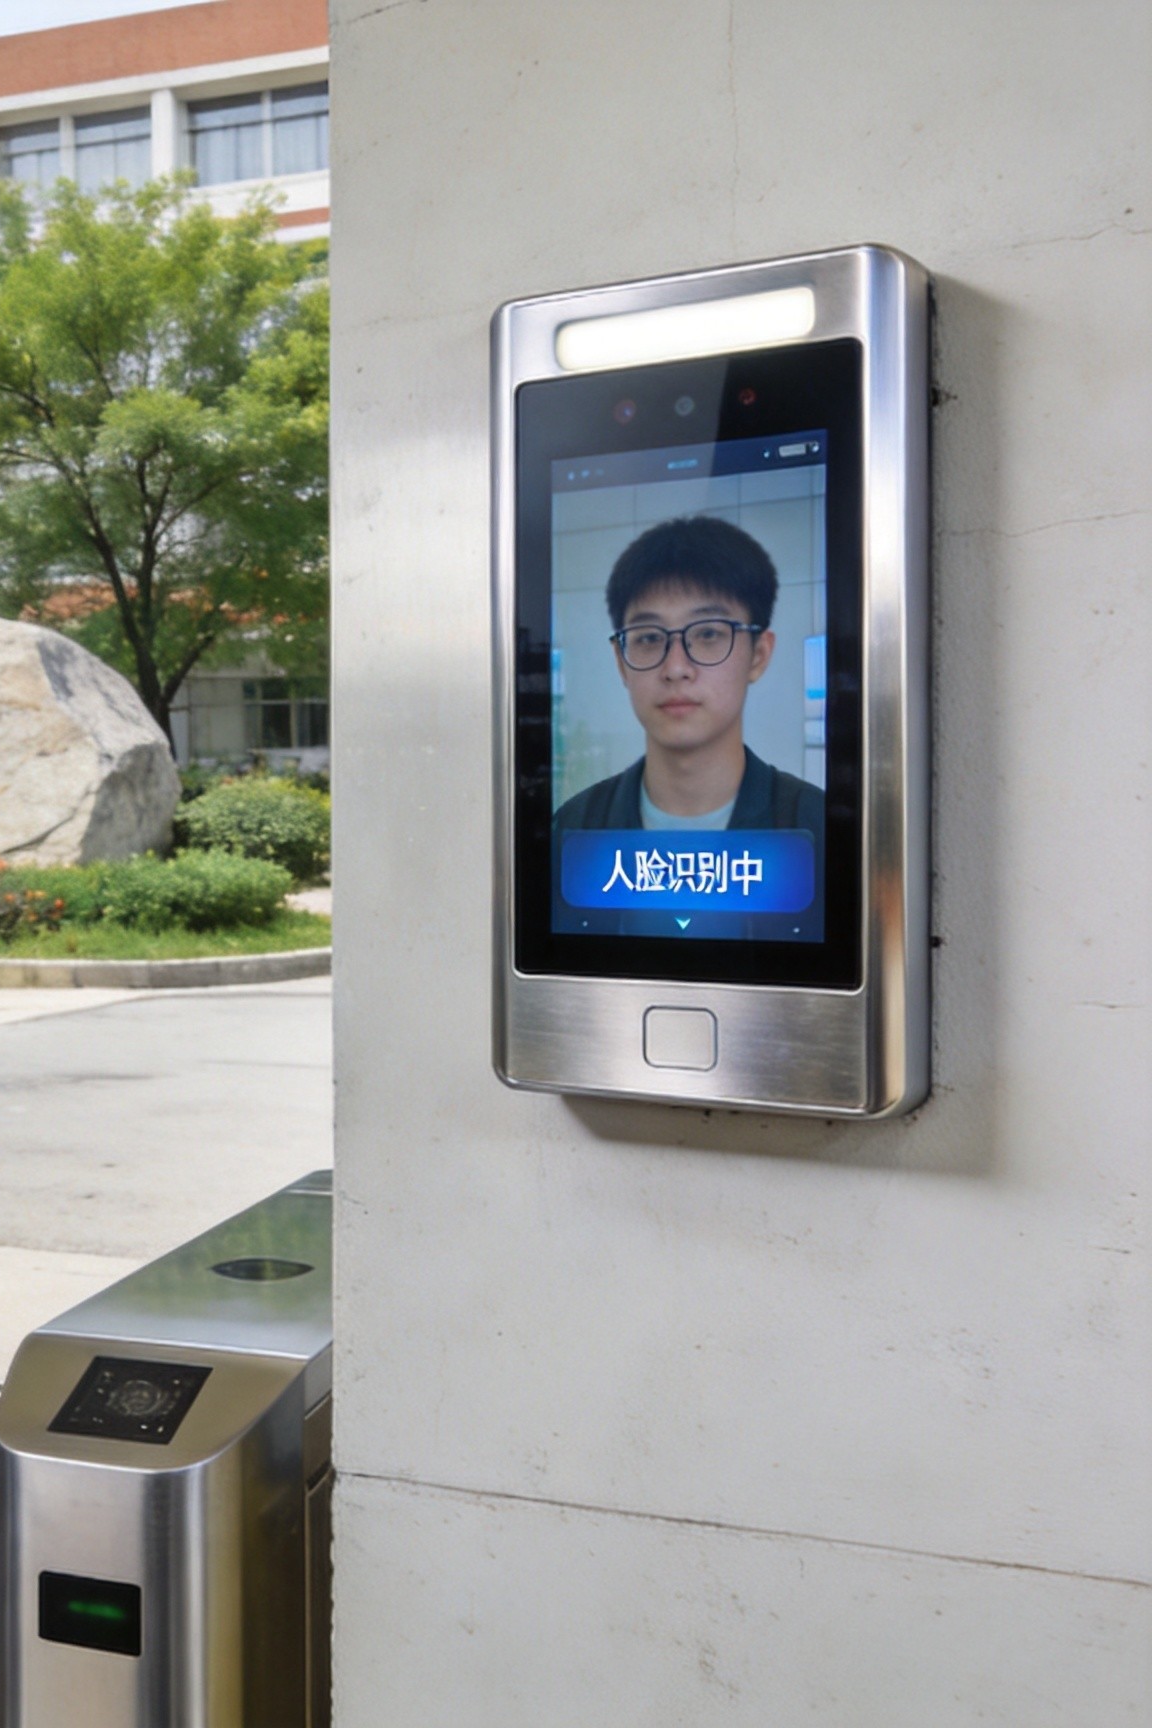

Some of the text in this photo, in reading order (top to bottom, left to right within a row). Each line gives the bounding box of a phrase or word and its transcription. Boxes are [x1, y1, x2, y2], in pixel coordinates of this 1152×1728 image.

[602, 848, 763, 896] 人脸识别中
